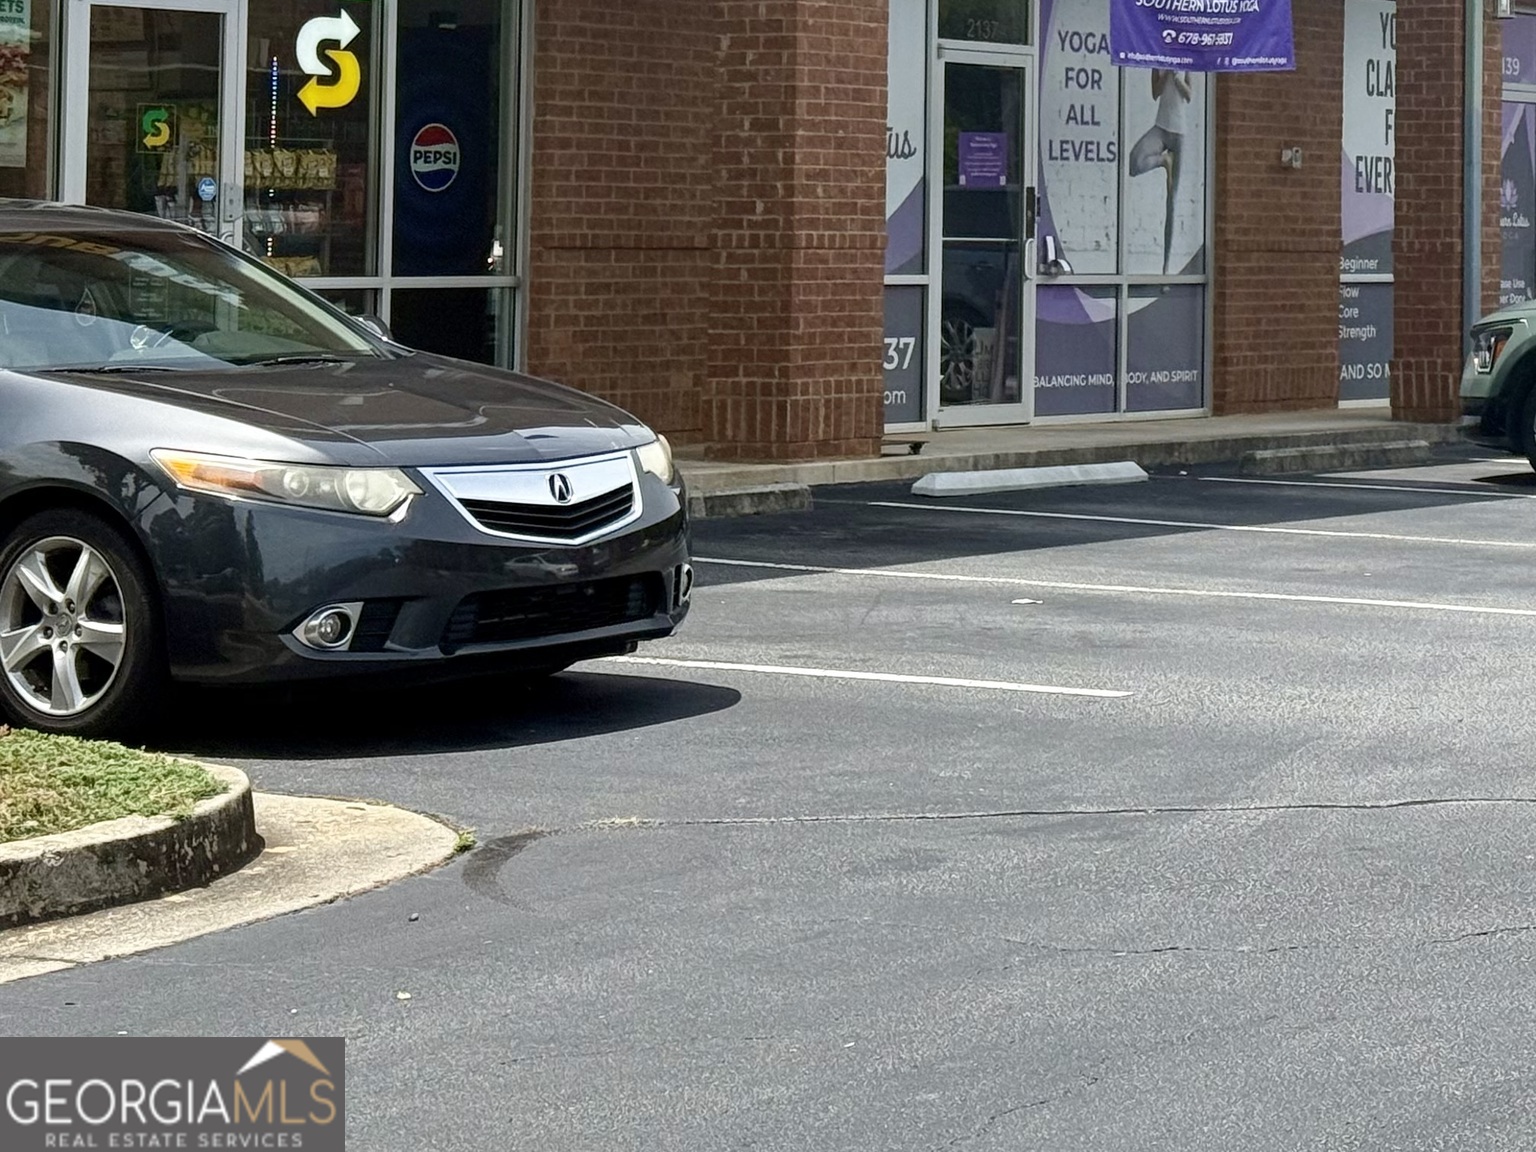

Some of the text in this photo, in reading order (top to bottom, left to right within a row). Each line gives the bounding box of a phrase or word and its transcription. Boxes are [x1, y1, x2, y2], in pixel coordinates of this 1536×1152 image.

[966, 18, 999, 39] 2137
[1058, 30, 1110, 55] YOGA
[1064, 67, 1103, 90] FOR
[1065, 104, 1101, 126] ALL
[886, 127, 917, 159] us
[1048, 139, 1117, 163] LEVELS
[413, 150, 457, 165] PEPSI
[1339, 324, 1377, 342] Strength
[1034, 374, 1087, 388] BALANCING
[1088, 373, 1115, 387] MIND,
[1150, 371, 1170, 383] AND
[1171, 370, 1199, 383] SPIRIT
[1340, 363, 1365, 380] AND
[1367, 362, 1382, 379] SO
